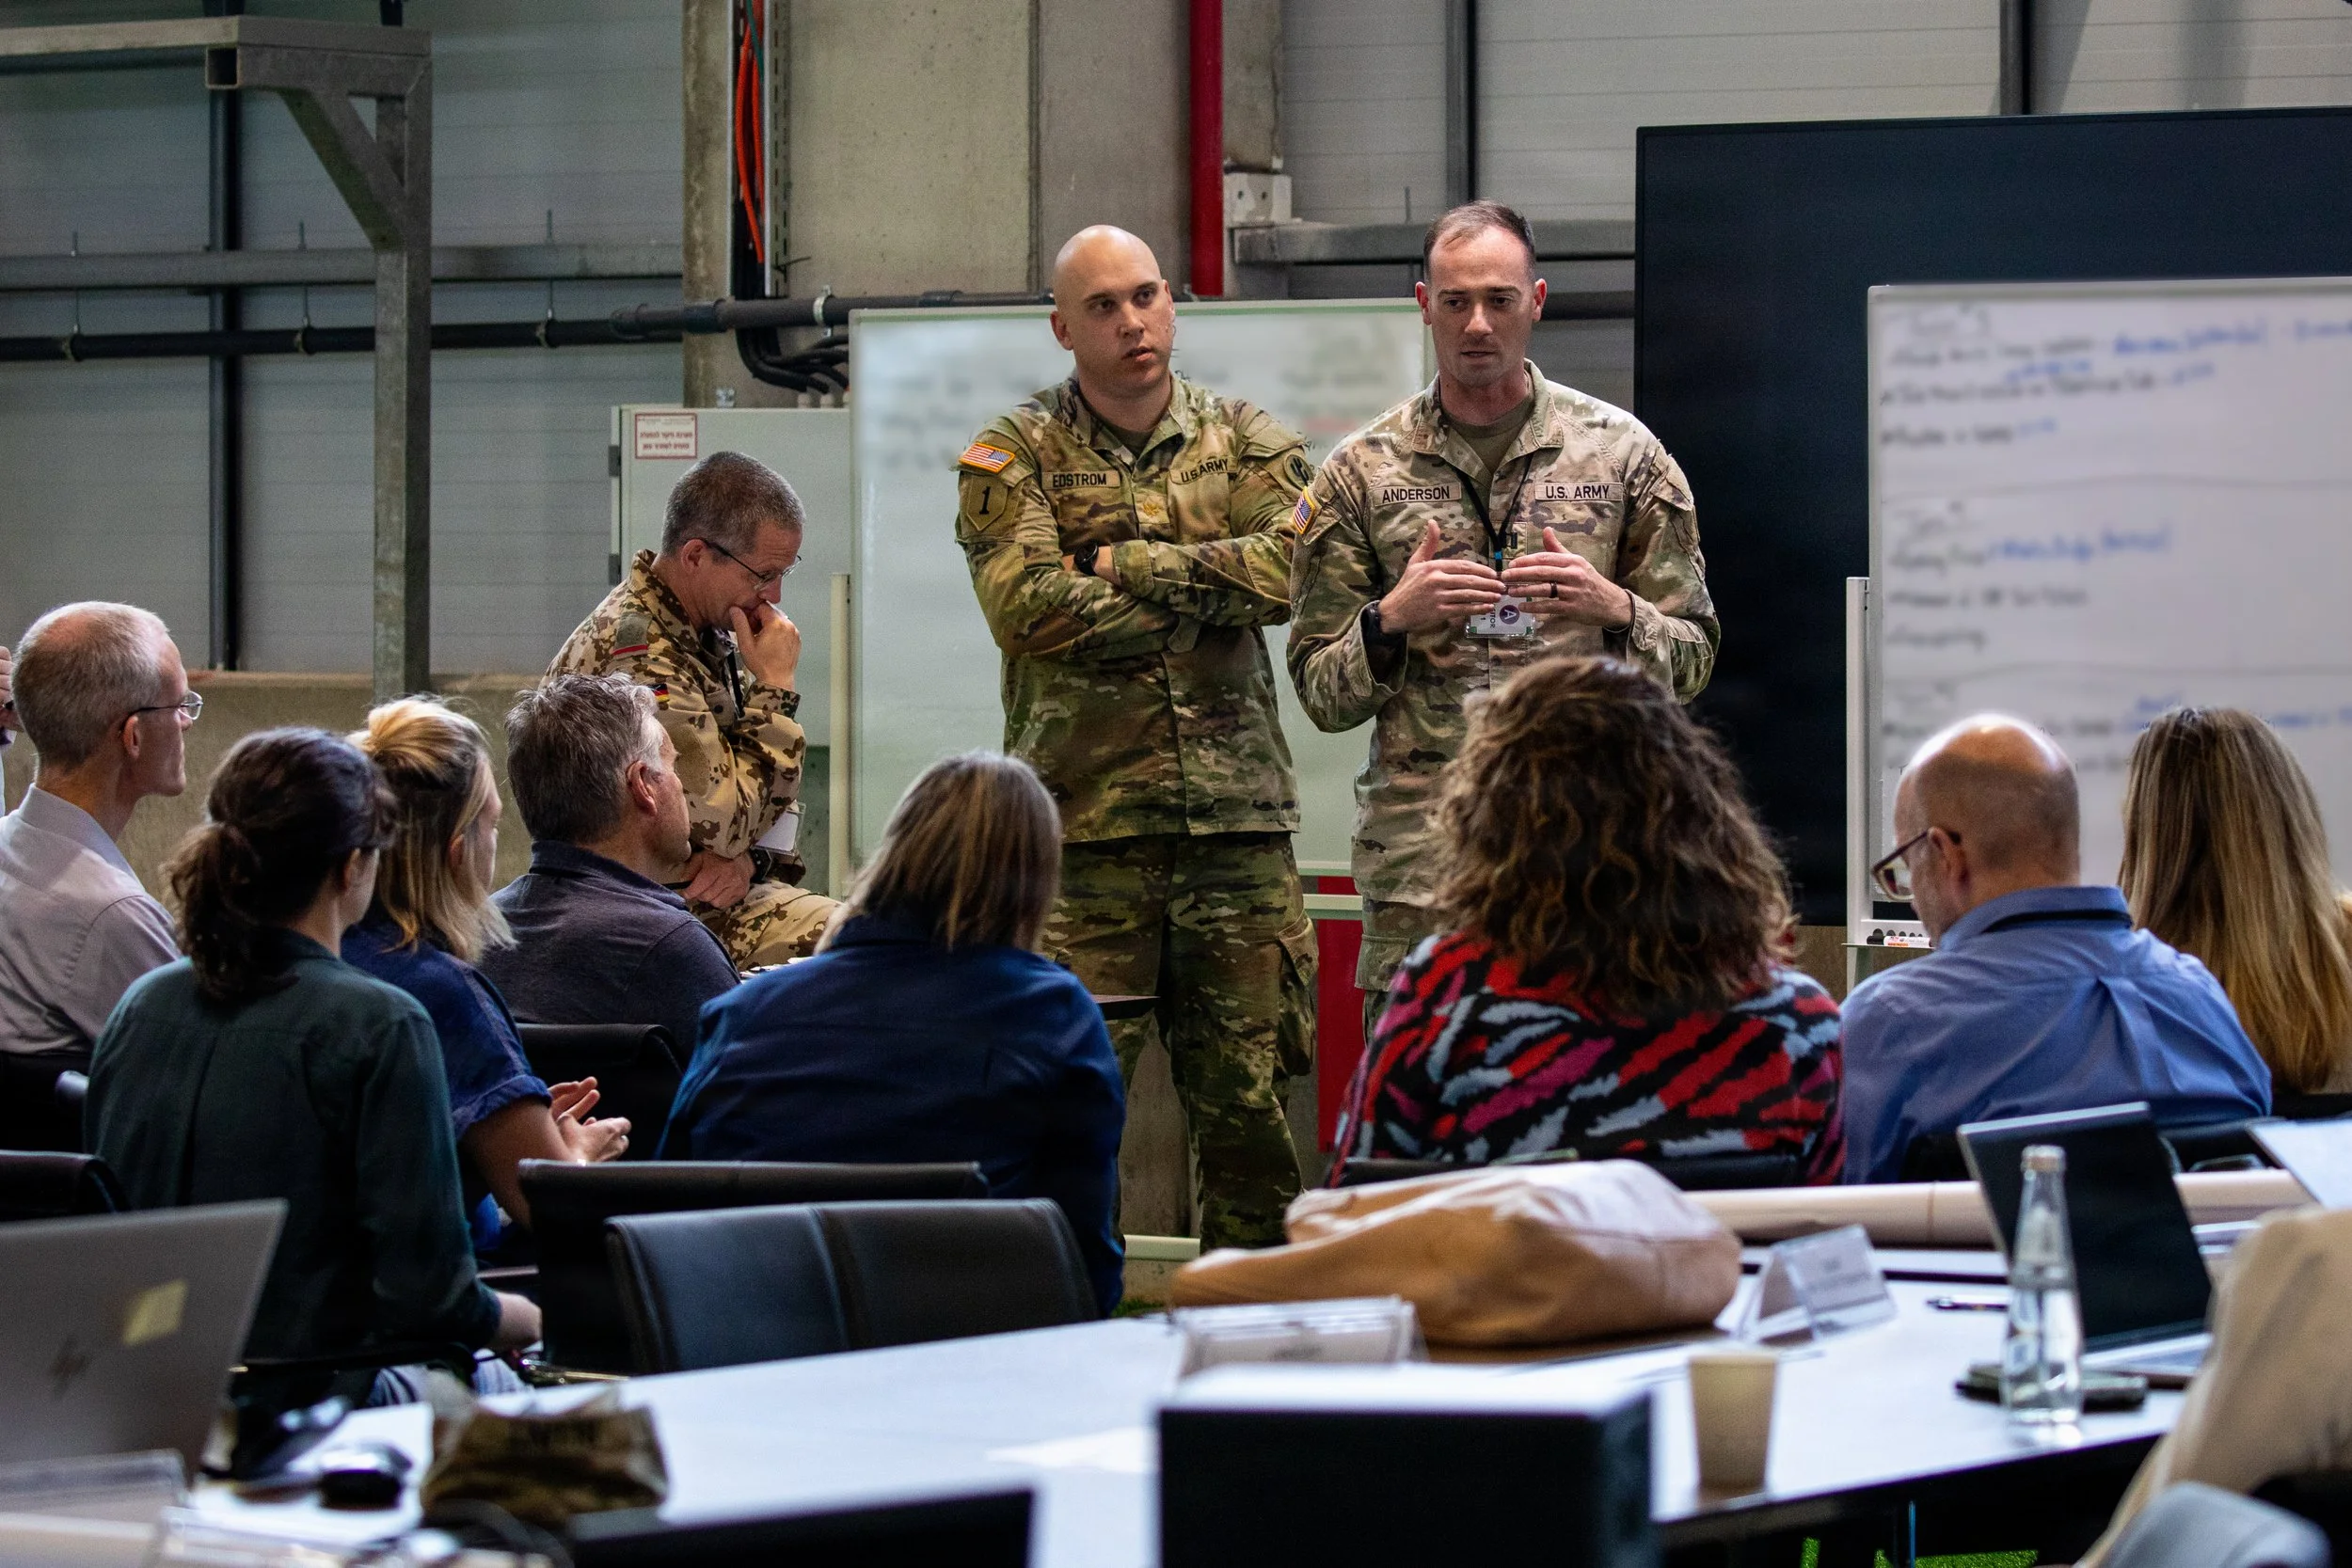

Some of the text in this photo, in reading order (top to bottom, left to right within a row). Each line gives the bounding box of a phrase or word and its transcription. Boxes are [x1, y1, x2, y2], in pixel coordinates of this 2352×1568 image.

[1200, 458, 1228, 475] ARMY
[1052, 472, 1107, 488] EDSTROM
[978, 485, 992, 515] 1
[1382, 485, 1450, 503] ANDERSON
[1546, 484, 1610, 499] U.S. ARMY
